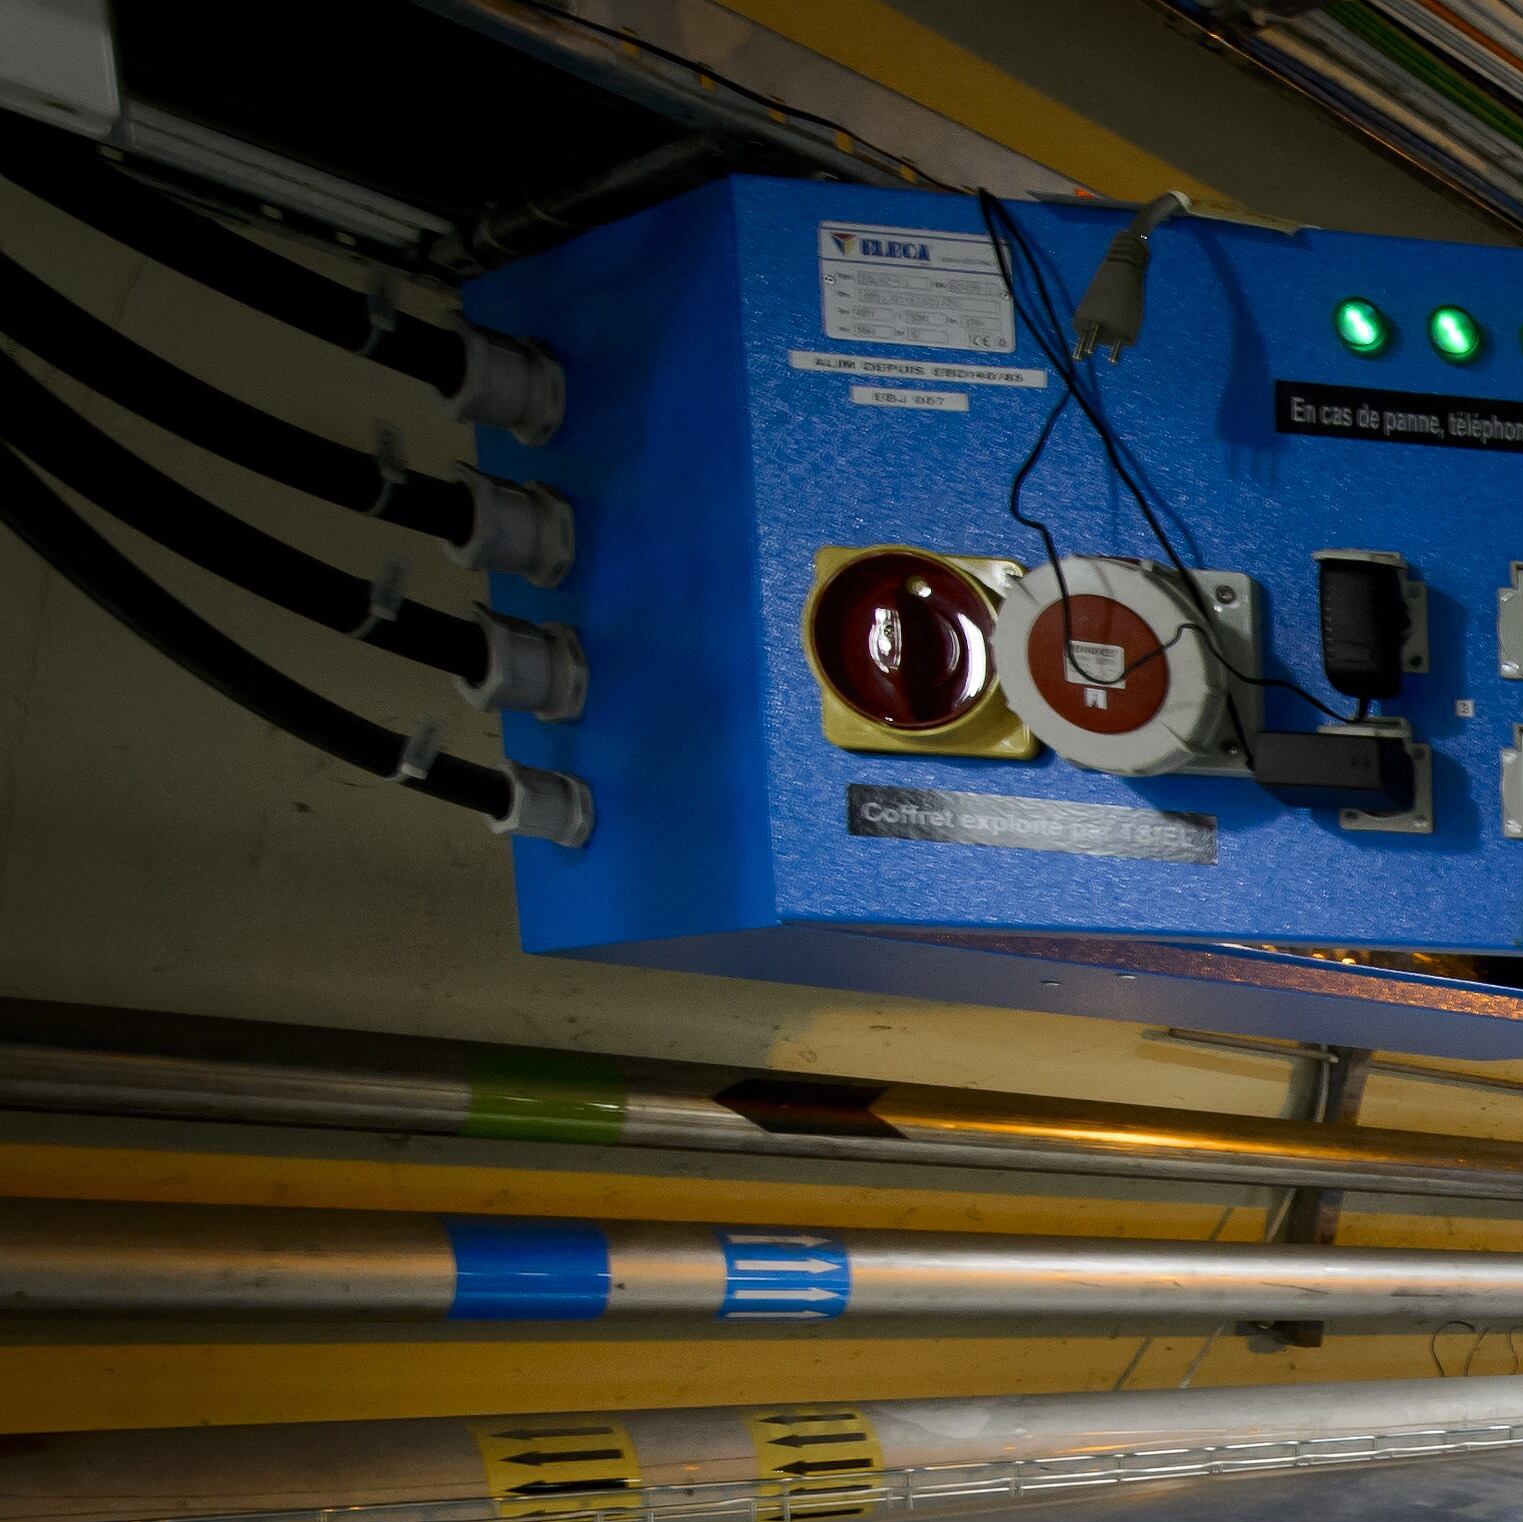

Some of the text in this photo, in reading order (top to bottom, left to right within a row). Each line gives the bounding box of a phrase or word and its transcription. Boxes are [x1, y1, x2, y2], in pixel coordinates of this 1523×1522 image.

[1290, 396, 1316, 424] En
[1319, 405, 1353, 427] cas
[1356, 403, 1380, 430] de
[1383, 411, 1445, 439] panne,
[861, 801, 954, 829] Coffret
